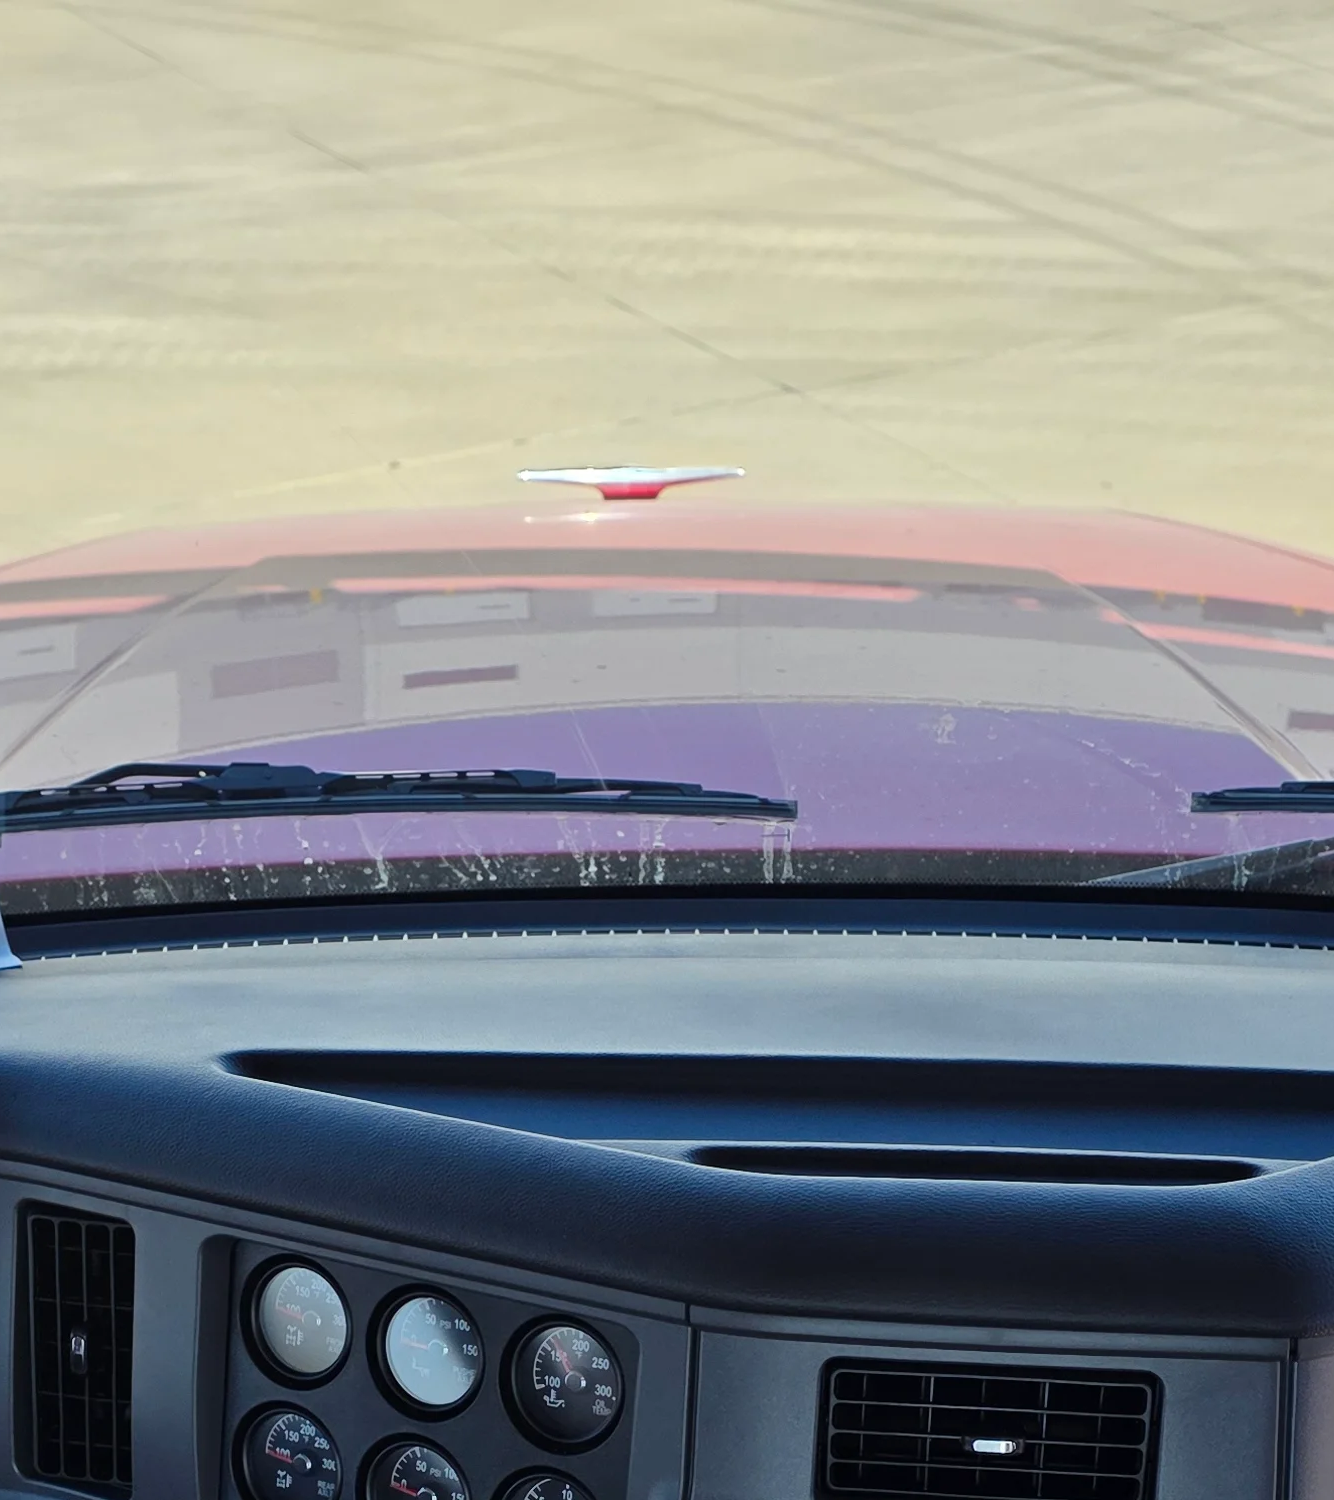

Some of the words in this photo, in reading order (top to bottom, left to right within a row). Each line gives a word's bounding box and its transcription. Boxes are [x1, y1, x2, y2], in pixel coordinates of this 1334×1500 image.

[295, 1285, 310, 1298] 150
[425, 1312, 437, 1326] 50
[439, 1320, 452, 1330] PSI
[462, 1343, 479, 1357] 150
[571, 1338, 590, 1353] 200
[591, 1356, 610, 1371] 250
[544, 1375, 561, 1389] 100
[594, 1383, 613, 1398] 300
[284, 1430, 300, 1443] 150
[299, 1423, 316, 1437] 200
[415, 1460, 427, 1473] 50
[429, 1467, 442, 1478] PSI
[562, 1489, 573, 1500] 10
